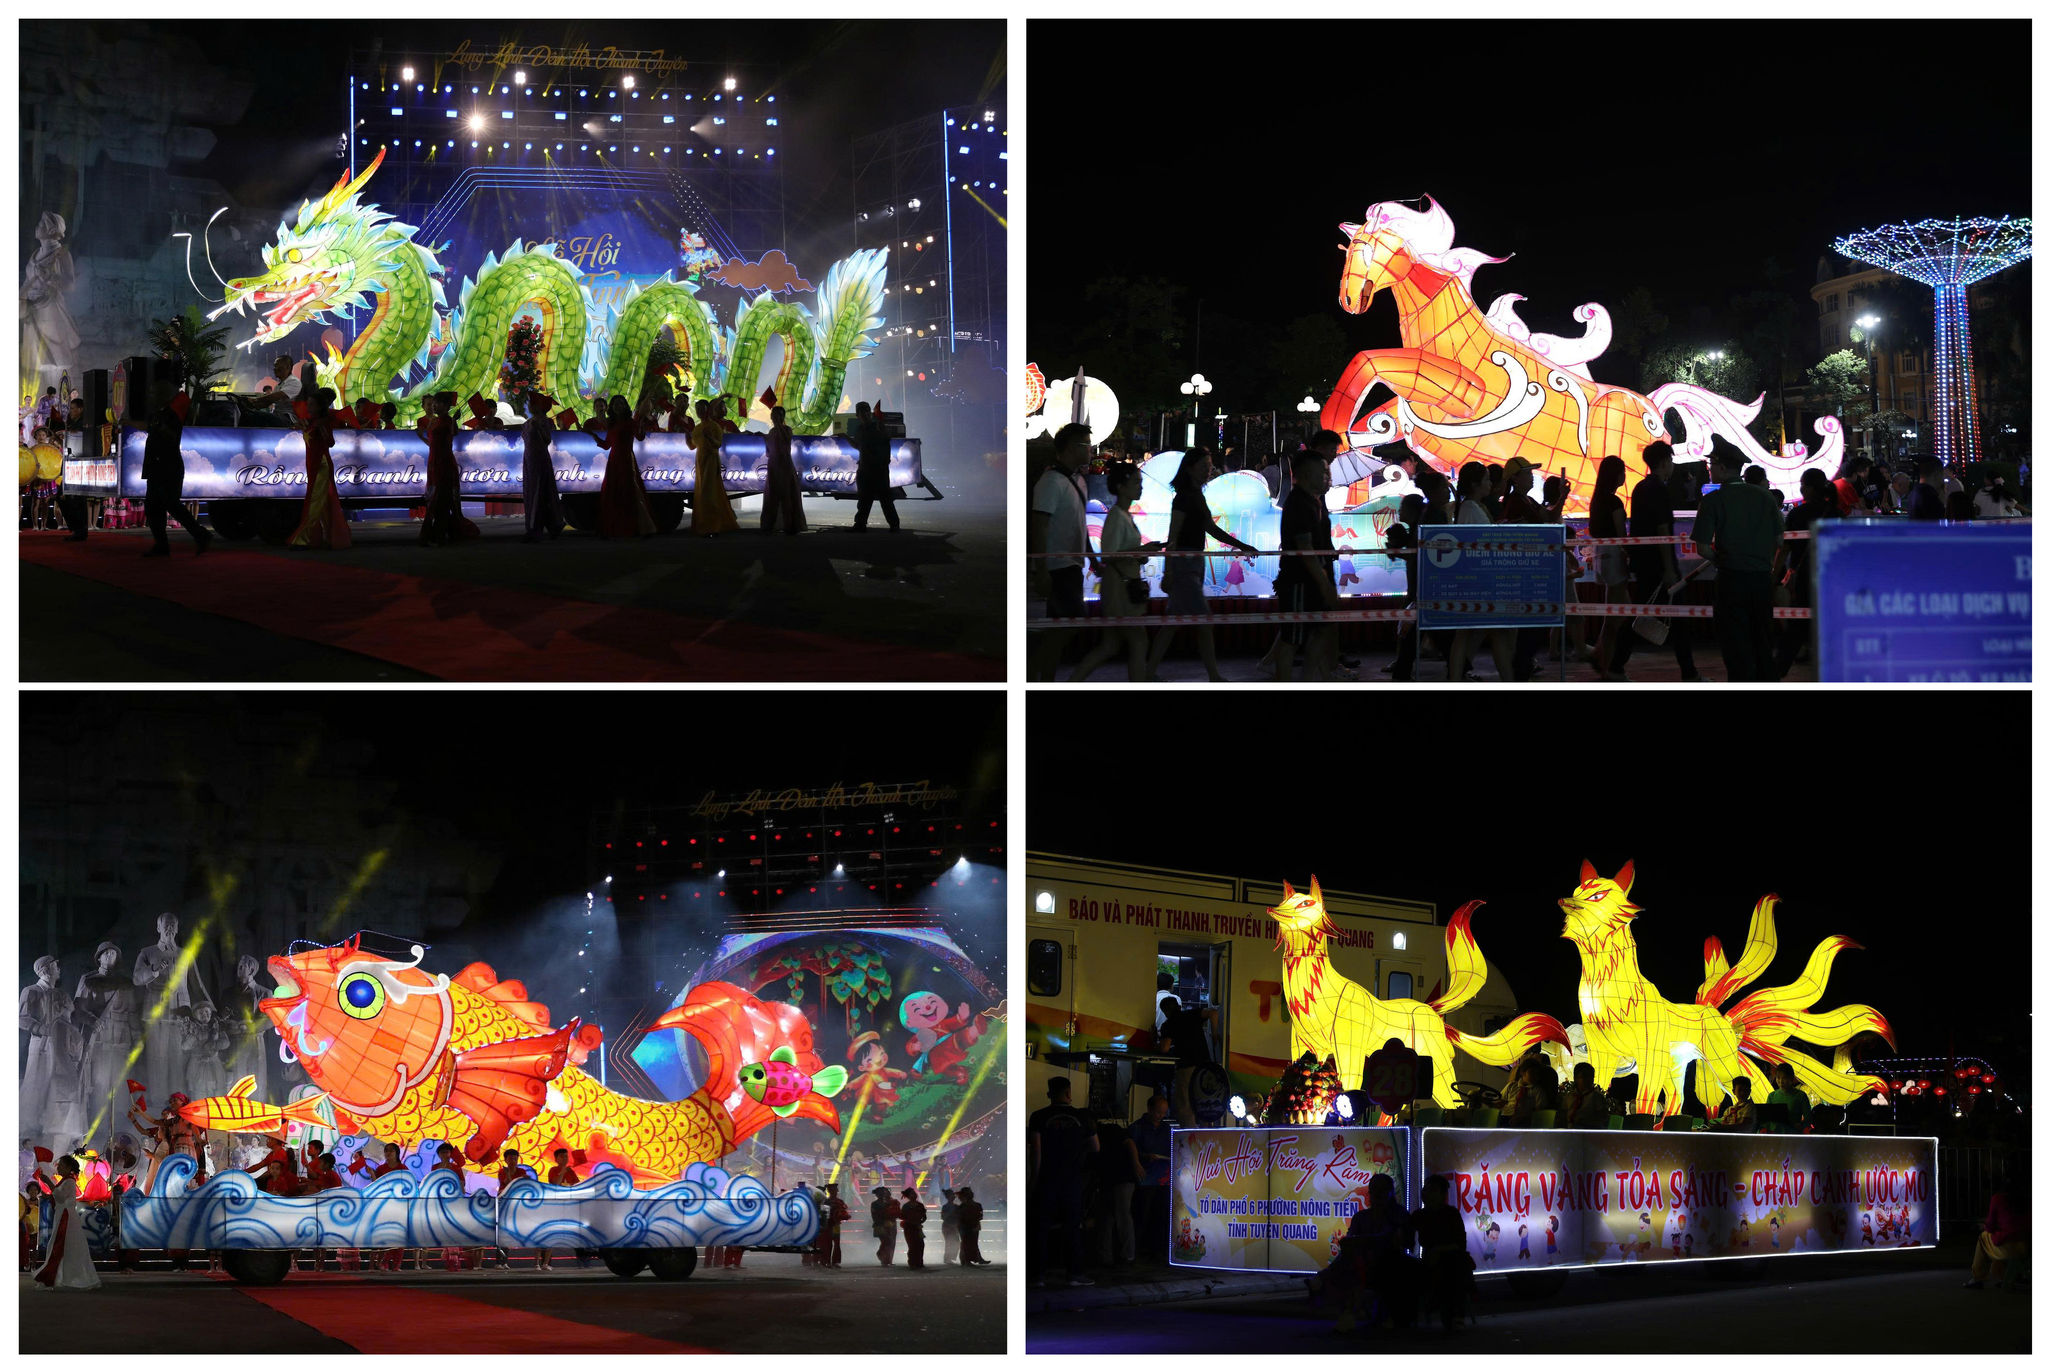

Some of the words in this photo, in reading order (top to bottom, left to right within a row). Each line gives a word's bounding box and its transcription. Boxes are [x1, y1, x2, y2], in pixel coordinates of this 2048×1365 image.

[234, 465, 308, 486] Rồn
[455, 464, 512, 483] ươn
[1879, 589, 1915, 616] CÁC
[1068, 896, 1099, 921] BÁO
[1103, 899, 1122, 923] VÀ
[1126, 899, 1162, 929] PHÁT
[1337, 929, 1374, 950] QUANG
[1370, 1064, 1414, 1098] 28
[1224, 1133, 1263, 1184] Hội
[1266, 1135, 1318, 1192] Trăng
[1538, 1162, 1609, 1215] VÀNG
[1615, 1155, 1665, 1213] TỎA
[1669, 1164, 1729, 1208] SÁNG
[1211, 1197, 1228, 1215] DÂN
[1230, 1195, 1248, 1215] PHỐ
[1250, 1199, 1255, 1215] 6
[1300, 1198, 1331, 1217] NÔNG
[1228, 1219, 1247, 1239] TỈNH
[1283, 1222, 1318, 1240] QUANG
